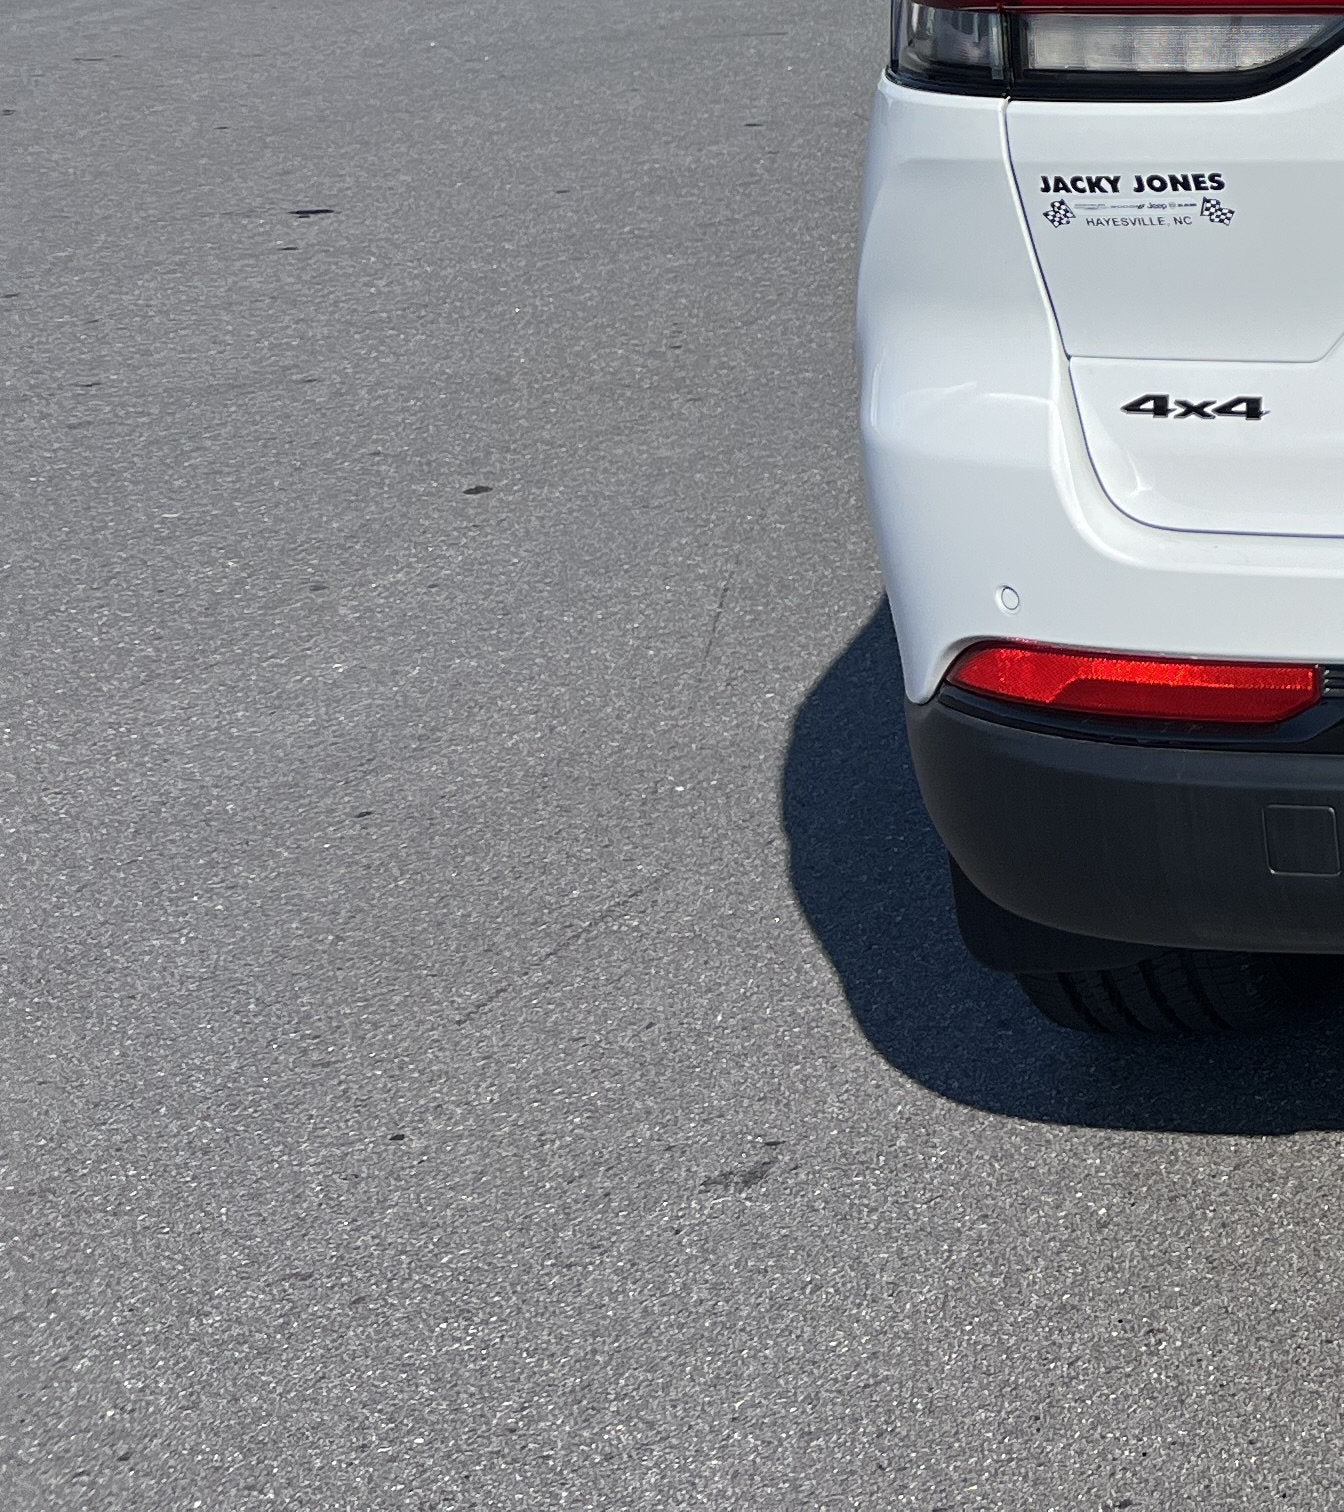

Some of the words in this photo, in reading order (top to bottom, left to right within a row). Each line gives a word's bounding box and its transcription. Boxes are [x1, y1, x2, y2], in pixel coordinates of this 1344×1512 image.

[1040, 175, 1121, 194] JACKY
[1133, 172, 1226, 193] JONES
[1086, 217, 1170, 227] HAYESVILLE,
[1173, 216, 1193, 225] NC
[1120, 394, 1270, 420] 4x4
